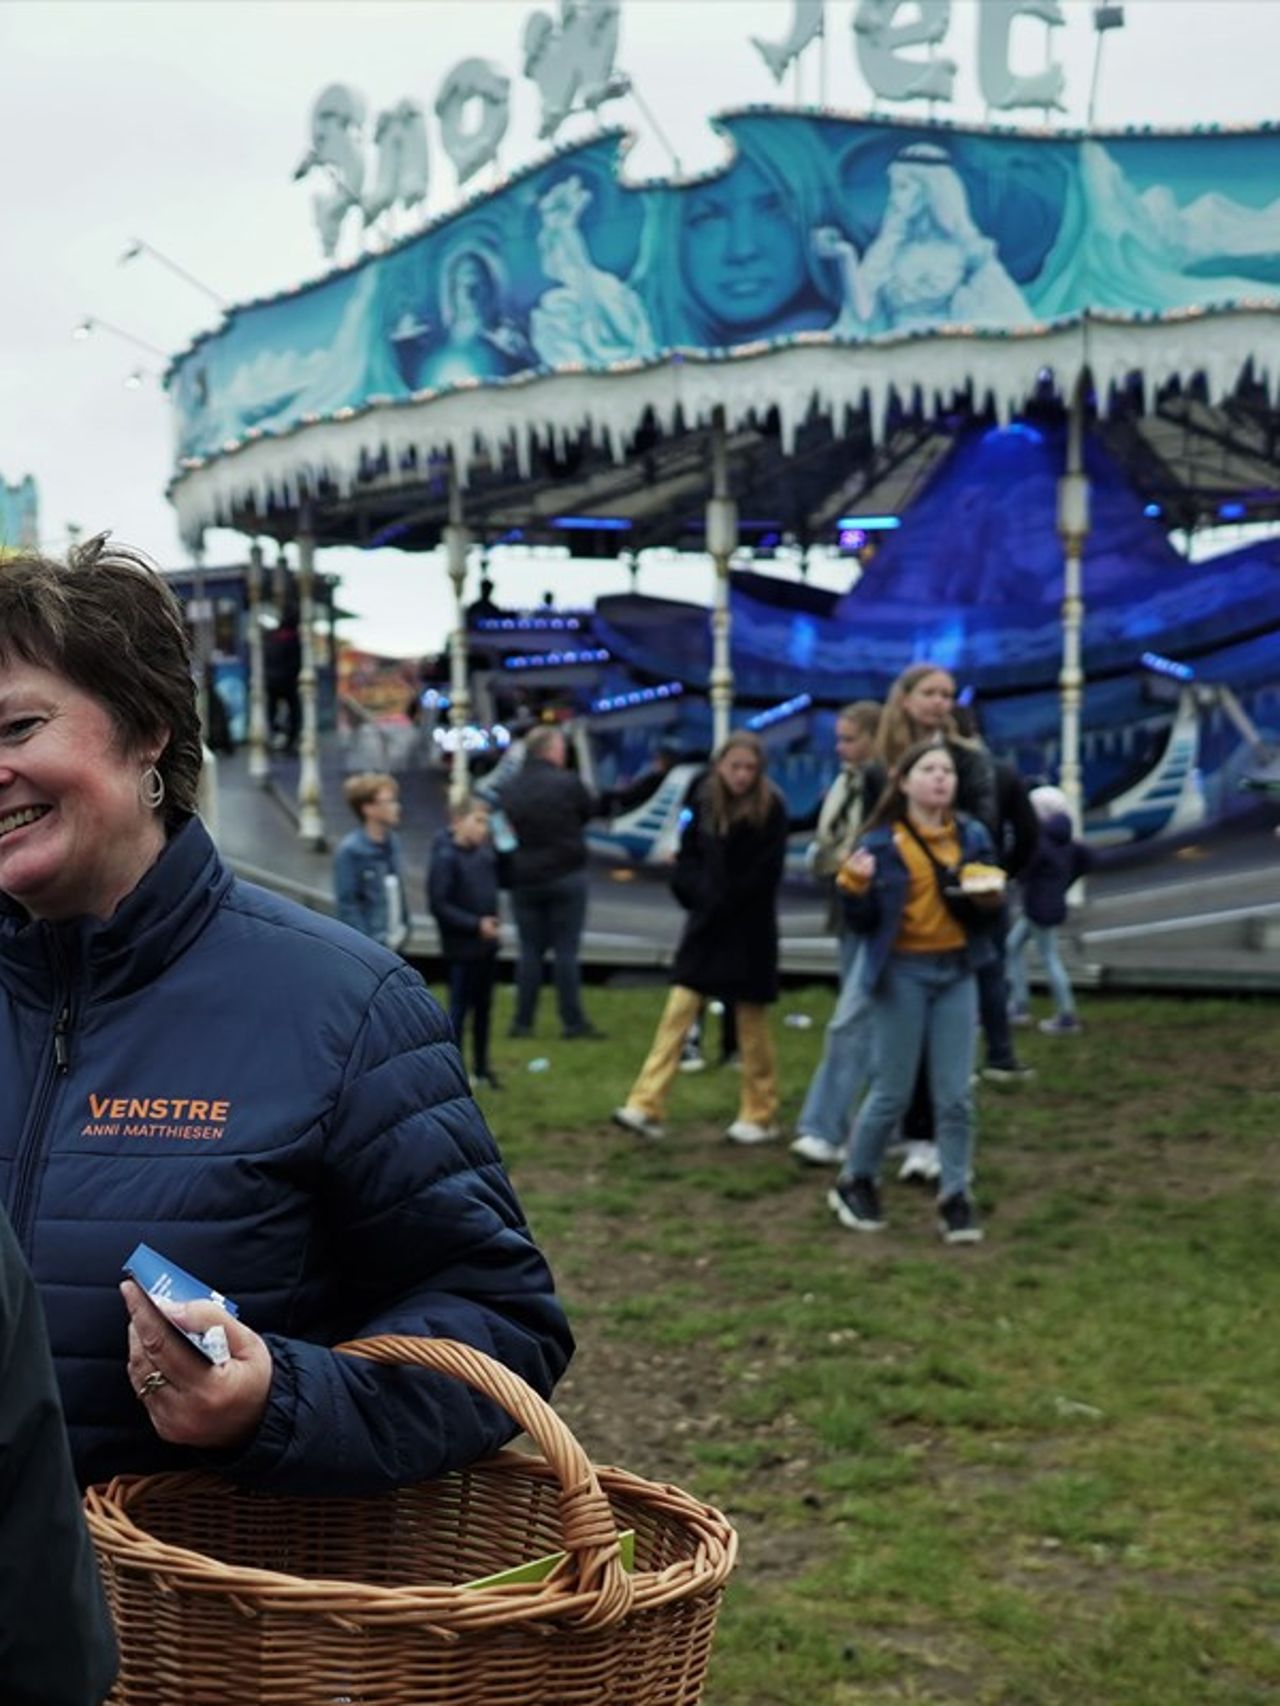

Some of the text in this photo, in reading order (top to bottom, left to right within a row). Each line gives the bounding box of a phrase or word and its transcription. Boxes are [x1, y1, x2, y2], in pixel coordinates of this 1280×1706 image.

[89, 1094, 229, 1121] VENSTRE
[82, 1124, 223, 1139] ANNI MATTHIESEN
